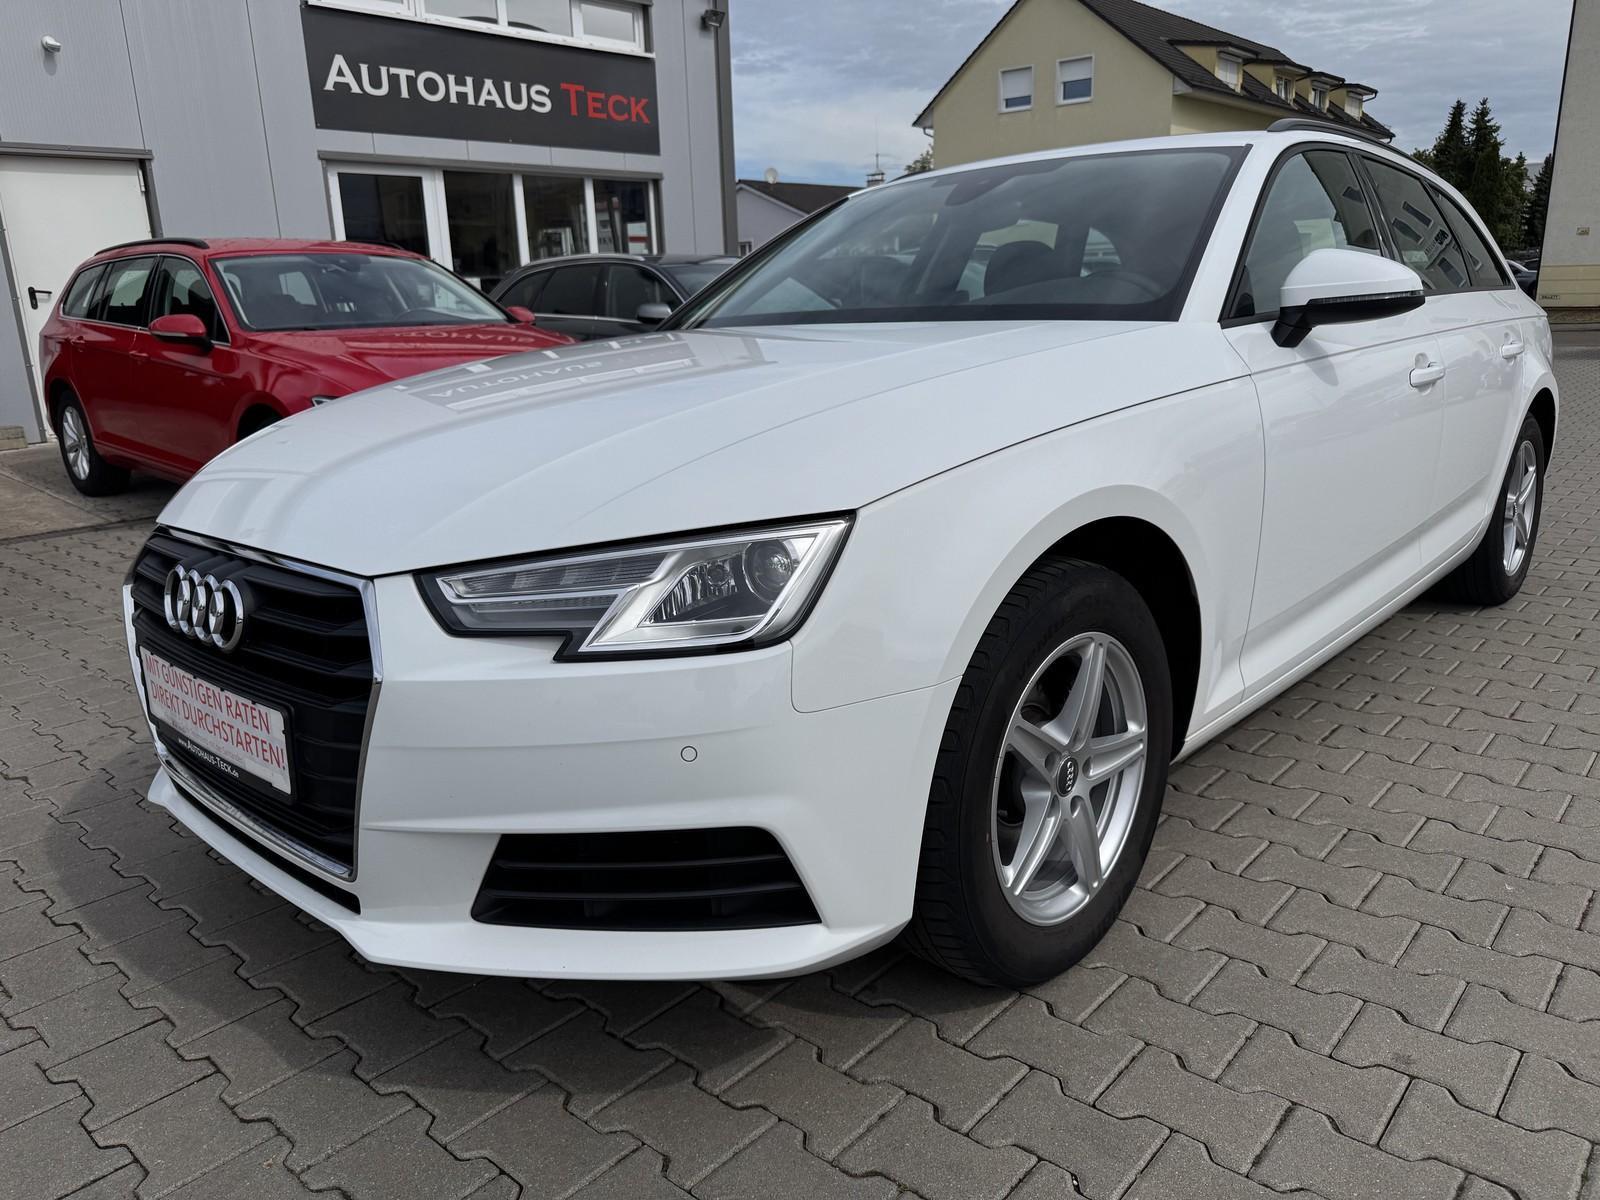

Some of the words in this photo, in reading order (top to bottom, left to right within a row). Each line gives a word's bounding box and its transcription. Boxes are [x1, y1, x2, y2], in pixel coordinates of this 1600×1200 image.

[323, 54, 552, 113] AUTOHAUS
[560, 82, 650, 124] TECK
[145, 654, 160, 678] MIT
[225, 695, 271, 735] RATEN
[151, 680, 181, 714] DIREKT
[181, 700, 286, 770] DURCHSTARTEN!
